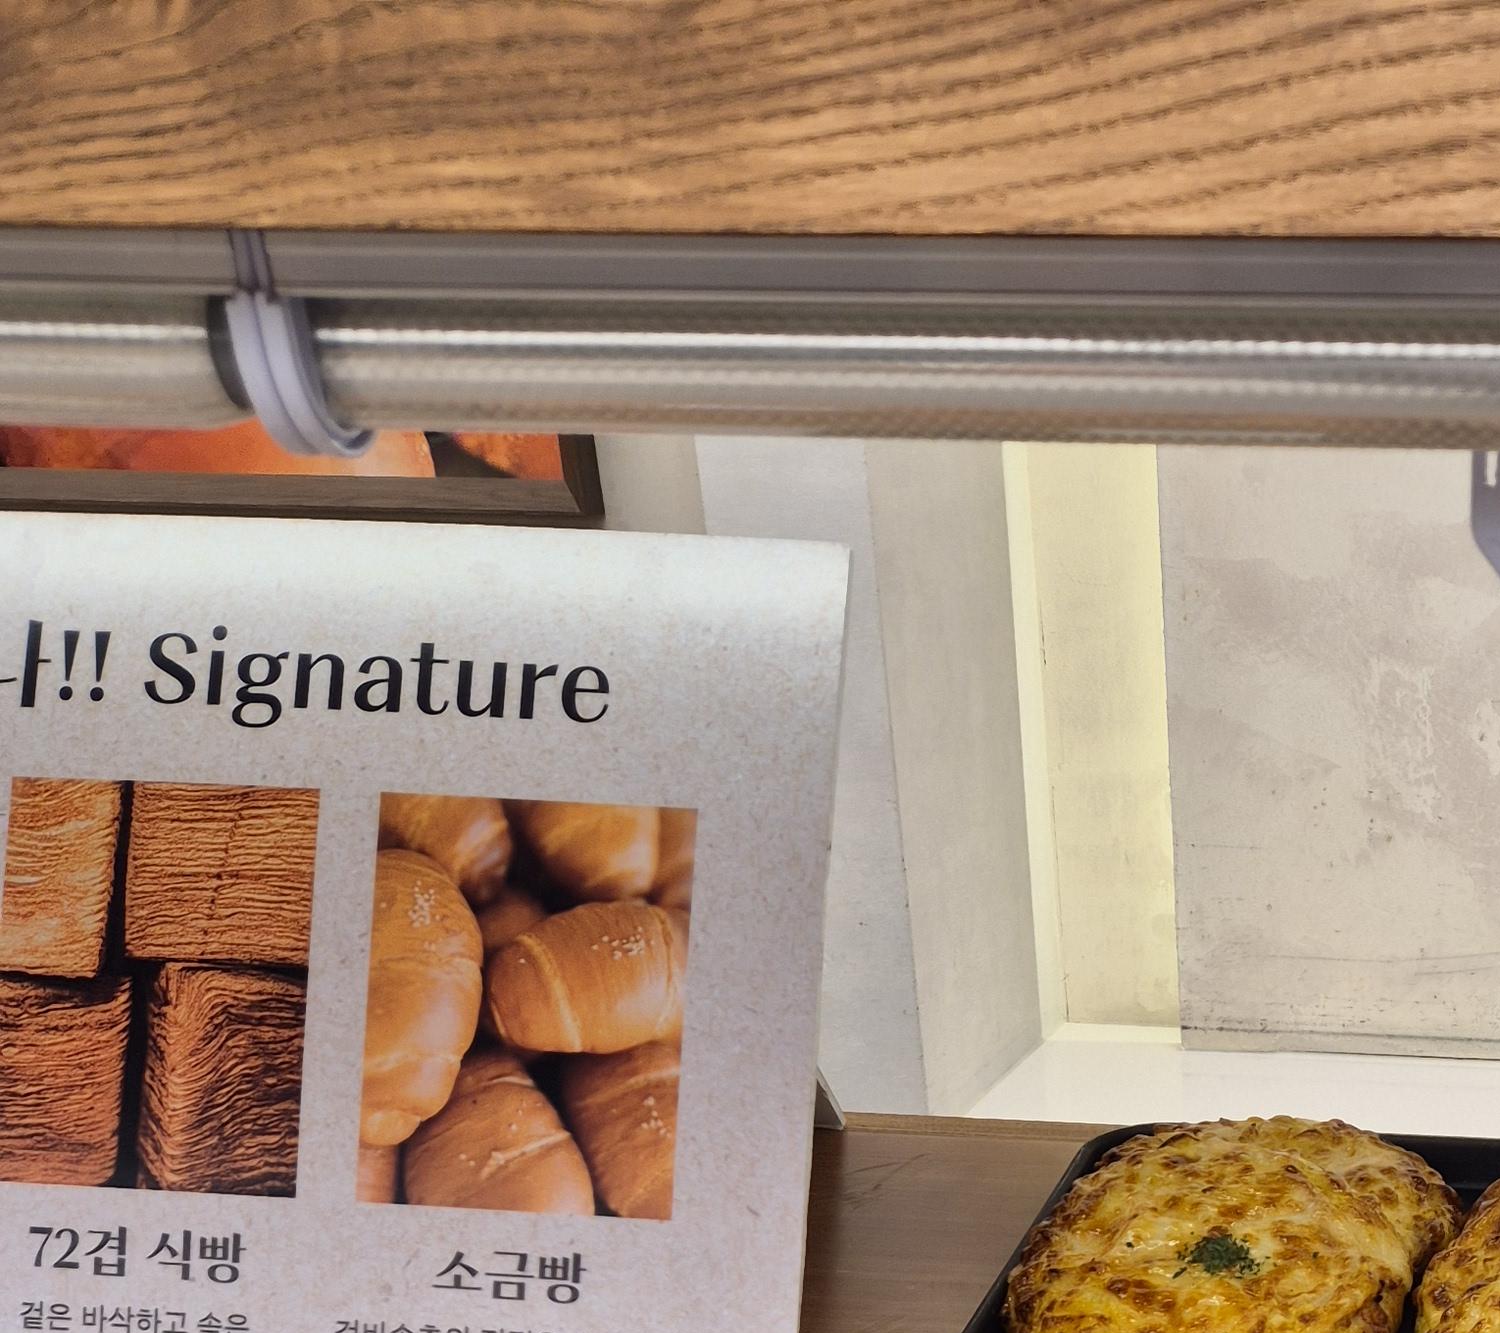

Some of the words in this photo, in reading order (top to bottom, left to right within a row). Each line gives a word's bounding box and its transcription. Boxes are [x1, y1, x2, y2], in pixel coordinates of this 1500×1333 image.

[144, 624, 610, 728] Signature
[29, 1226, 127, 1277] 72겹
[146, 1229, 247, 1283] 식빵
[432, 1251, 588, 1304] 소금빵
[19, 1301, 72, 1331] 겉은
